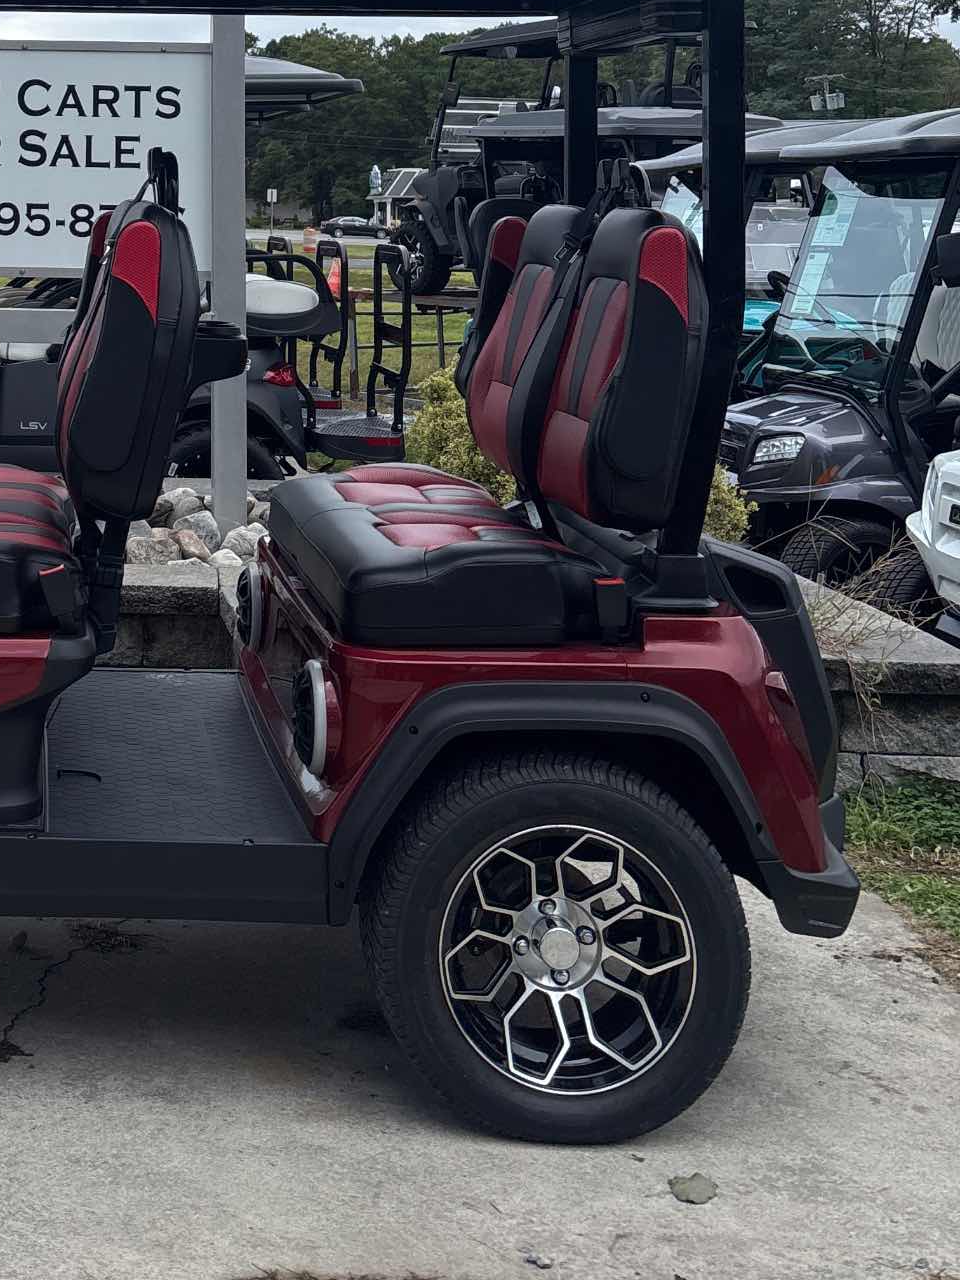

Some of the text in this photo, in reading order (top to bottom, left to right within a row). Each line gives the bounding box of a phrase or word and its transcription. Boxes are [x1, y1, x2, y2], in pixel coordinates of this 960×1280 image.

[17, 79, 182, 119] CARTS
[18, 129, 141, 169] SALE
[20, 421, 47, 430] LSV
